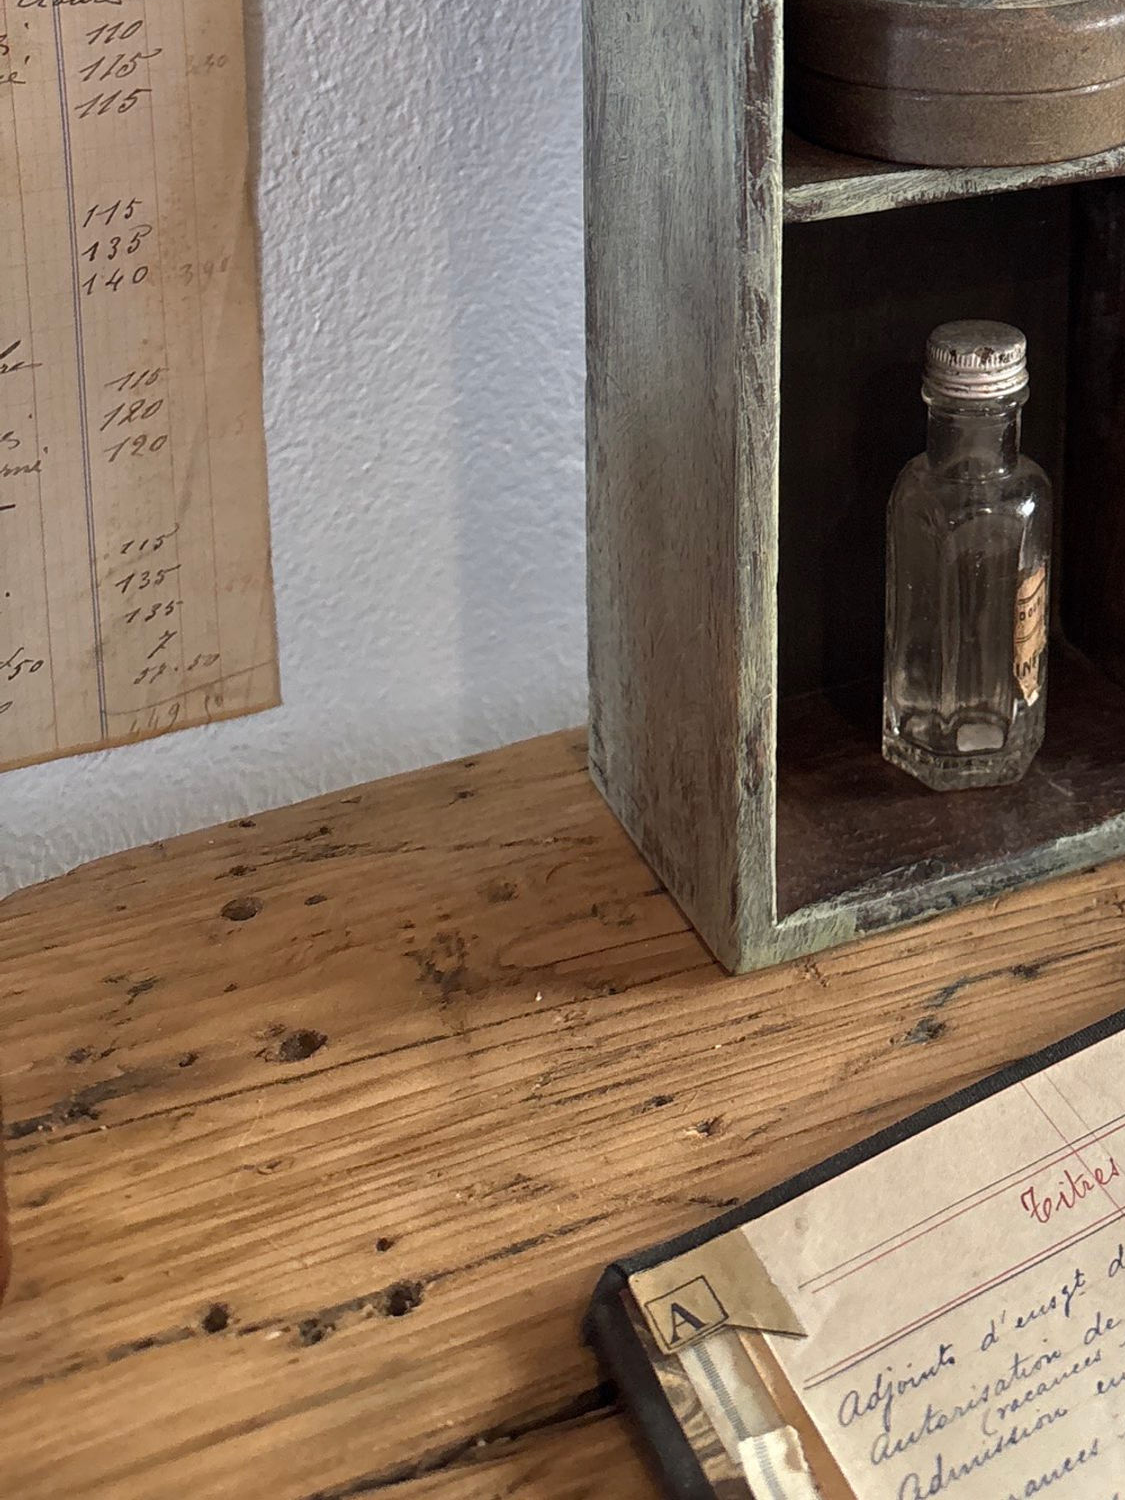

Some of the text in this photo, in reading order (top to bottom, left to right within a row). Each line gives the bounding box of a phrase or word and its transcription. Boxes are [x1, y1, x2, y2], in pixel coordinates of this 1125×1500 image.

[86, 20, 144, 45] 110
[80, 49, 162, 82] 115
[75, 89, 152, 120] 115
[83, 199, 143, 228] 115
[82, 224, 153, 261] 135
[83, 266, 149, 296] 140
[104, 368, 170, 392] 115
[101, 399, 164, 432] 120
[105, 434, 168, 462] 120
[119, 522, 180, 555] 115
[116, 565, 182, 594] 135
[125, 600, 184, 624] 135
[669, 1302, 710, 1346] A
[1083, 1310, 1123, 1346] de
[837, 1343, 956, 1432] Adjoints
